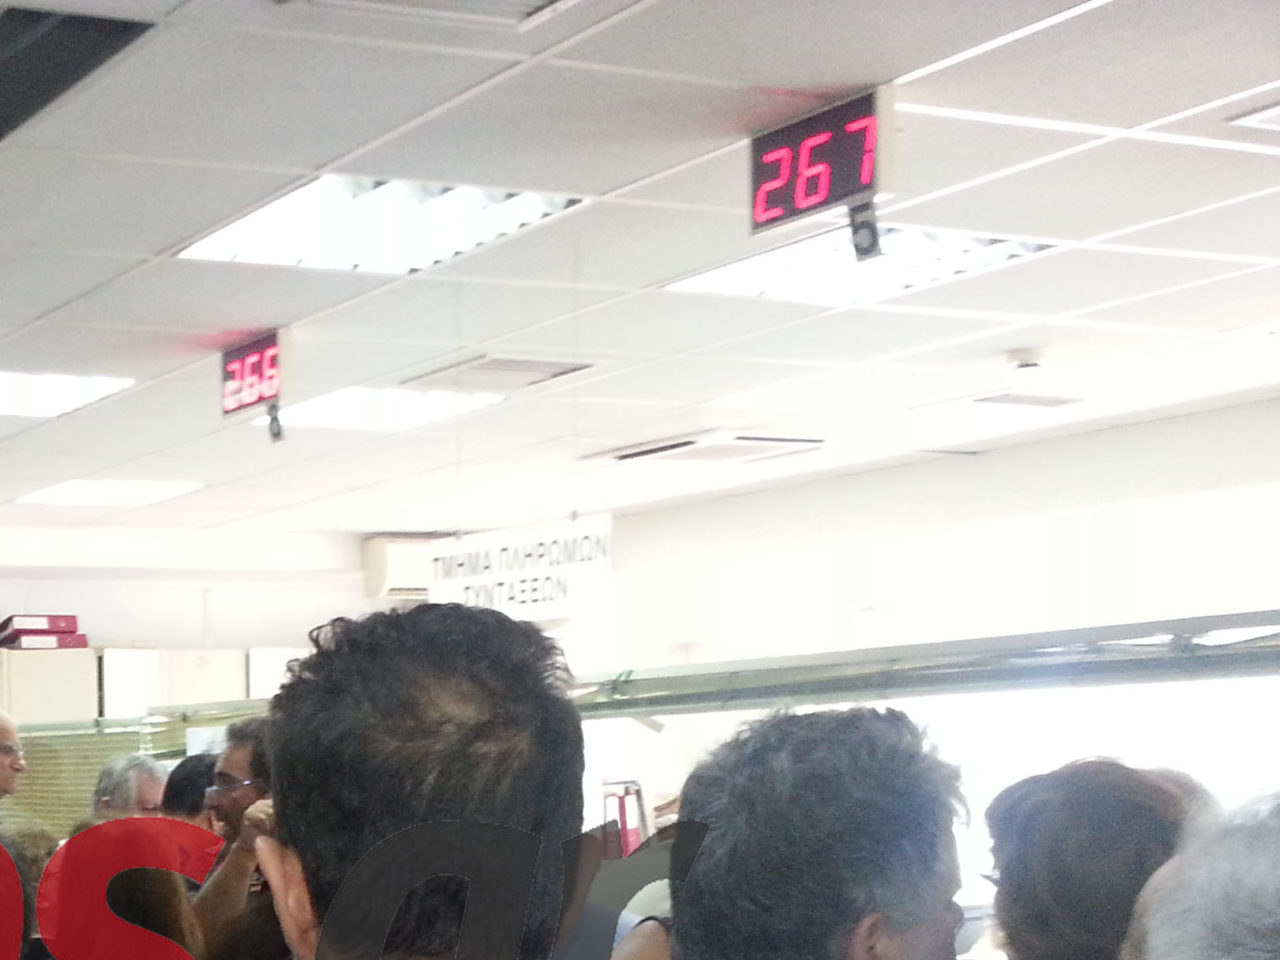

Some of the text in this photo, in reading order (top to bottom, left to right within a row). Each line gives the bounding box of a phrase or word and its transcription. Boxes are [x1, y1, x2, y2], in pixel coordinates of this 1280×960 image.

[753, 116, 878, 223] 267
[223, 345, 281, 411] 266
[432, 550, 492, 581] ΤΜΗΜΑ
